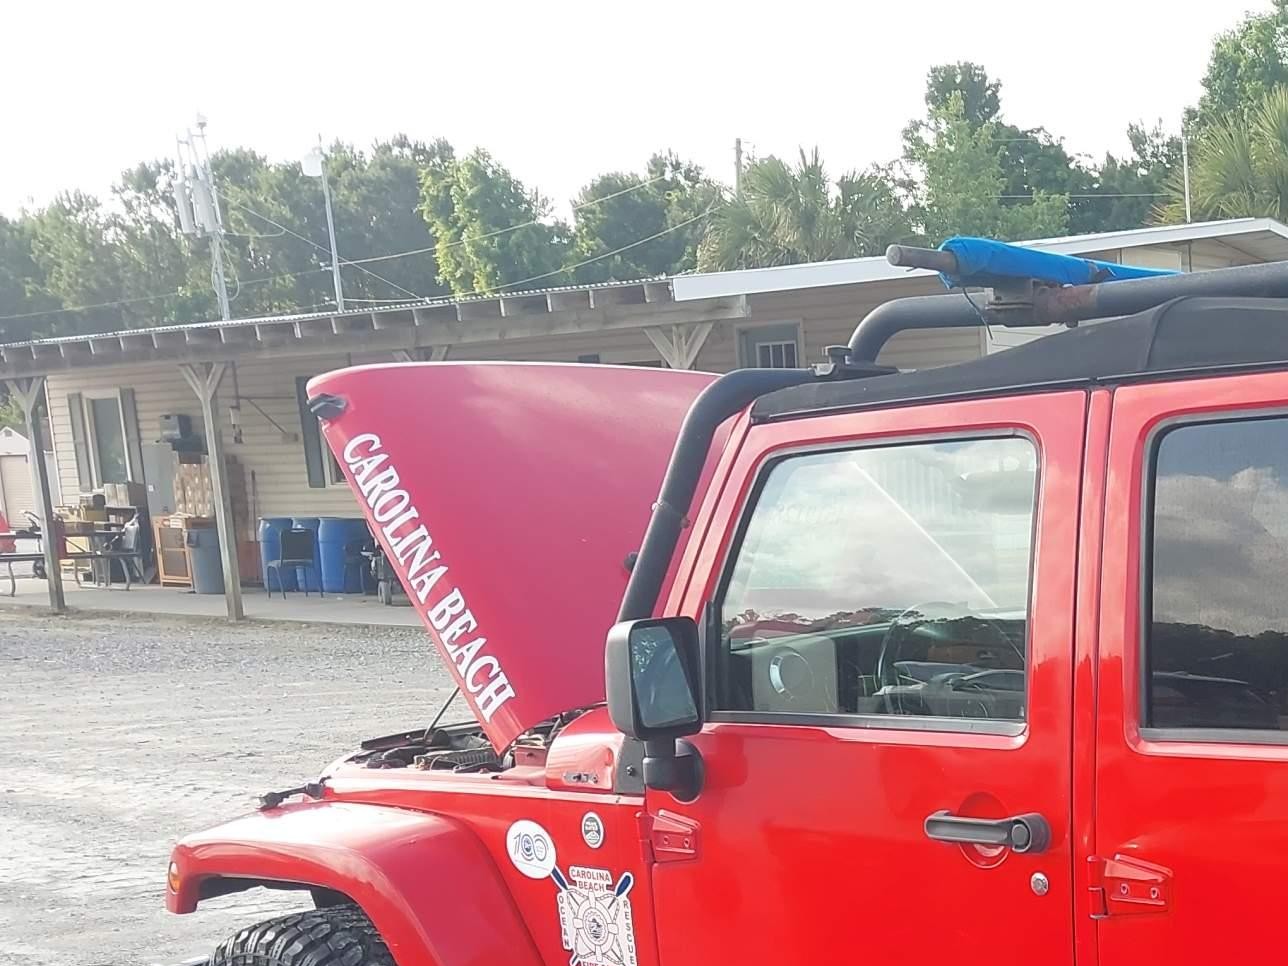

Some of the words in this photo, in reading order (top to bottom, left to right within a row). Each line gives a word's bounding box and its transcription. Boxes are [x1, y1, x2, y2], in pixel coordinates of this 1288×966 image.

[344, 433, 448, 604] CAROLINA
[429, 588, 515, 721] BEACH
[571, 870, 610, 882] CAROLINA
[578, 880, 605, 892] BEACH
[623, 901, 635, 964] RESCUE
